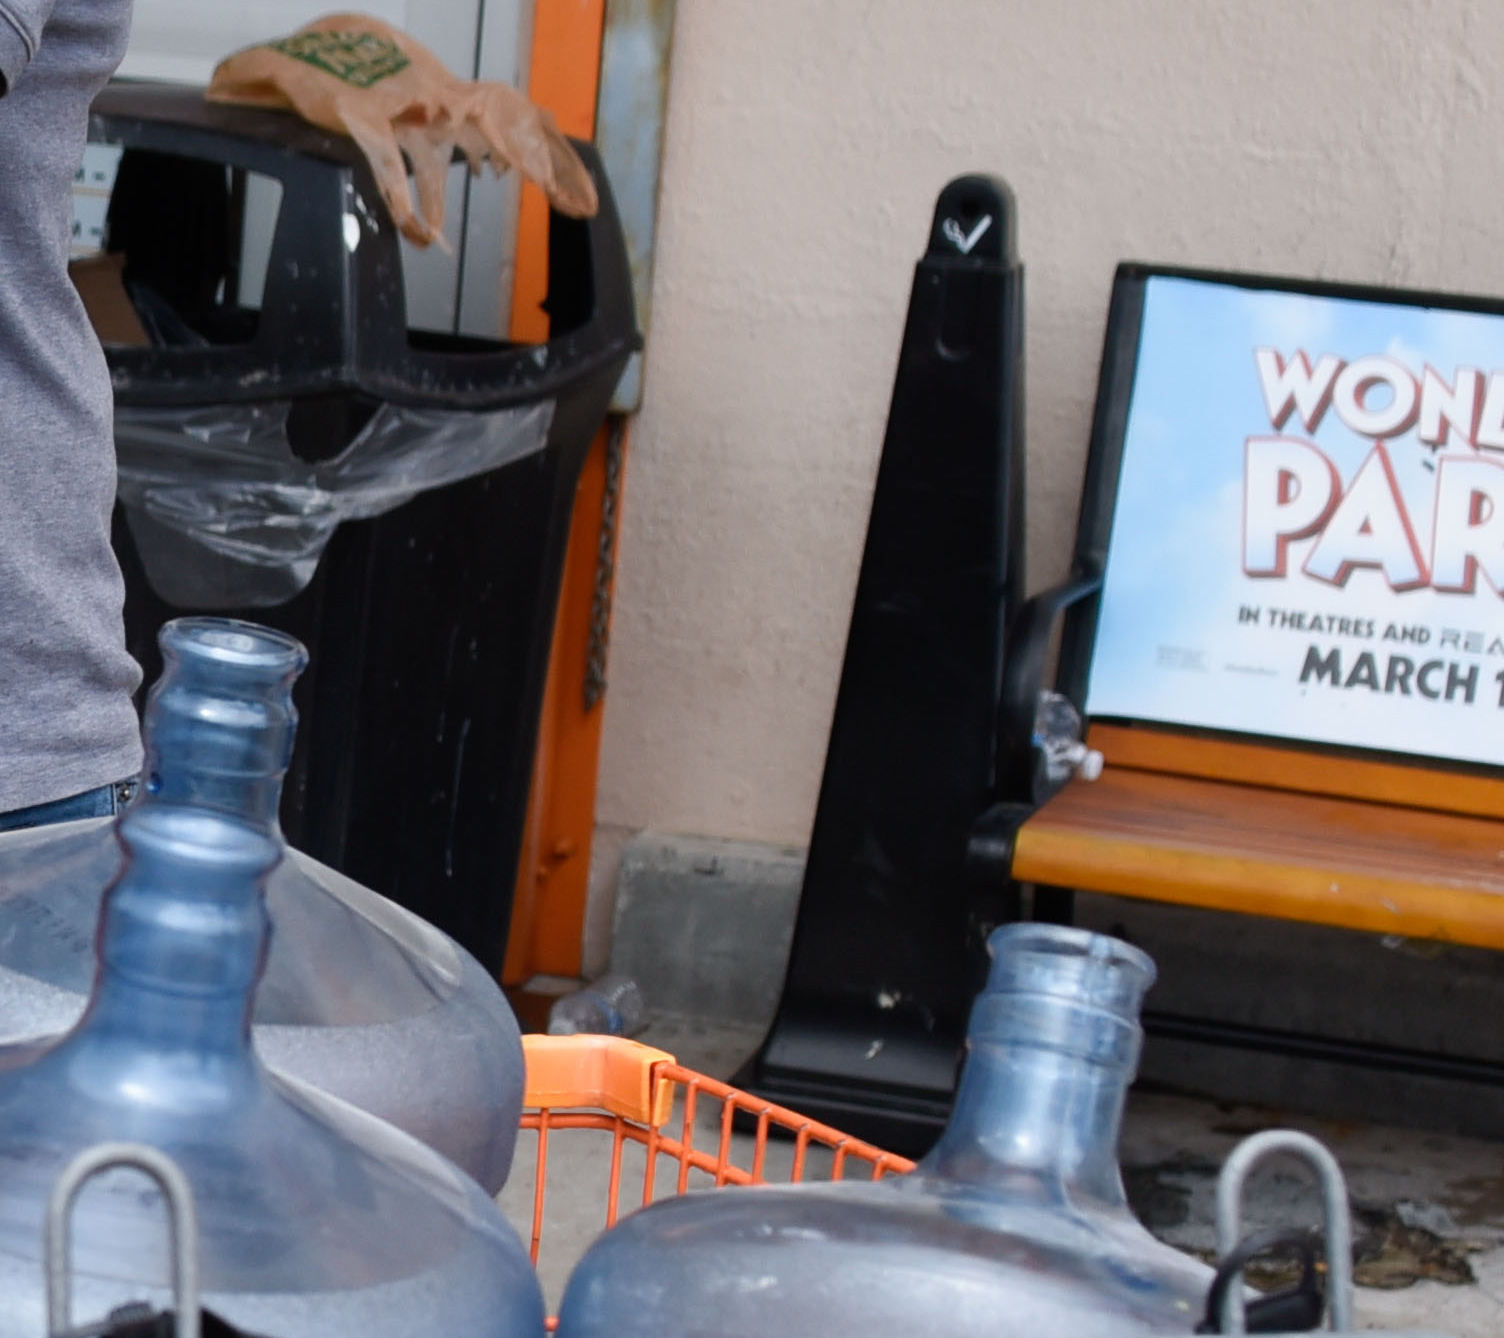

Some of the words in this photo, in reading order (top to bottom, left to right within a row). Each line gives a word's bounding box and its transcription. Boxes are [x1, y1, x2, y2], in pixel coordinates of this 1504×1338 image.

[1237, 605, 1260, 626] IN
[1268, 609, 1375, 641] THEATRES
[1382, 624, 1431, 646] AND
[1298, 645, 1479, 705] MARCH
